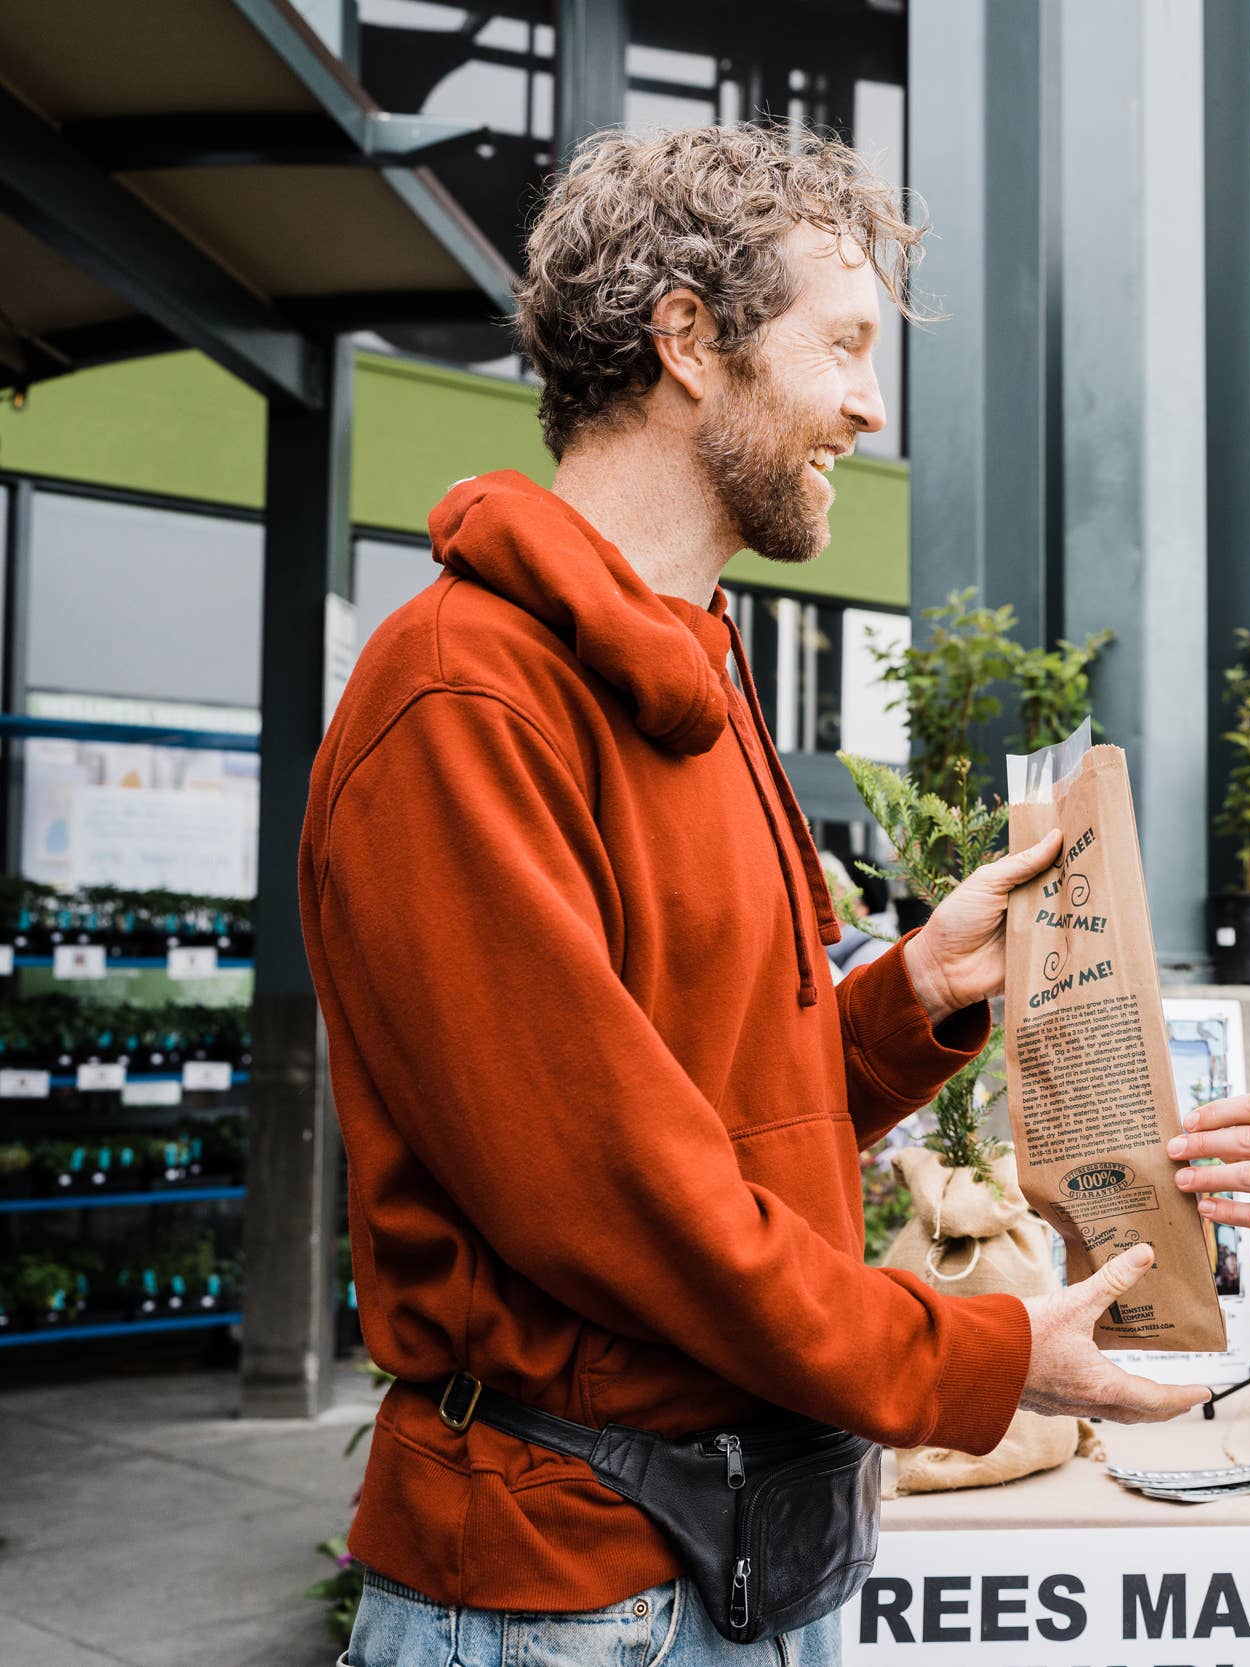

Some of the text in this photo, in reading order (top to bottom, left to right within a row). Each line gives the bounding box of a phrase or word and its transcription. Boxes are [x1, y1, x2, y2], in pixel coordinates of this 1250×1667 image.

[1035, 909, 1107, 933] PLANT ME!
[1029, 960, 1114, 1008] GROW ME!
[1073, 1004, 1084, 1012] you
[1083, 1009, 1096, 1017] feet
[1092, 1014, 1118, 1022] location
[1089, 1023, 1109, 1032] gallon
[1083, 1033, 1096, 1041] with
[1097, 1039, 1112, 1048] your
[1068, 1061, 1083, 1070] your
[1130, 1049, 1145, 1058] plug
[1065, 1078, 1075, 1086] the
[1089, 1072, 1103, 1082] plug
[1135, 1065, 1148, 1073] just
[1107, 1078, 1119, 1086] and
[1128, 1082, 1150, 1090] Always
[1115, 1099, 1146, 1109] frequently
[1039, 1109, 1052, 1117] your
[1141, 1112, 1156, 1121] Your
[1085, 1115, 1098, 1123] root
[1079, 1132, 1093, 1141] high
[1094, 1128, 1121, 1137] nitrogen
[1064, 1143, 1079, 1152] good
[1083, 1149, 1095, 1157] you
[1095, 1146, 1105, 1154] for
[1106, 1143, 1132, 1151] planting
[1133, 1139, 1145, 1147] this
[1076, 1170, 1117, 1190] 100%
[1068, 1180, 1128, 1198] GUARANTEED
[1087, 1226, 1117, 1244] PLANTING
[1121, 1305, 1153, 1315] JONSTEEN
[1122, 1312, 1154, 1320] COMPANY
[859, 1573, 1087, 1644] REES
